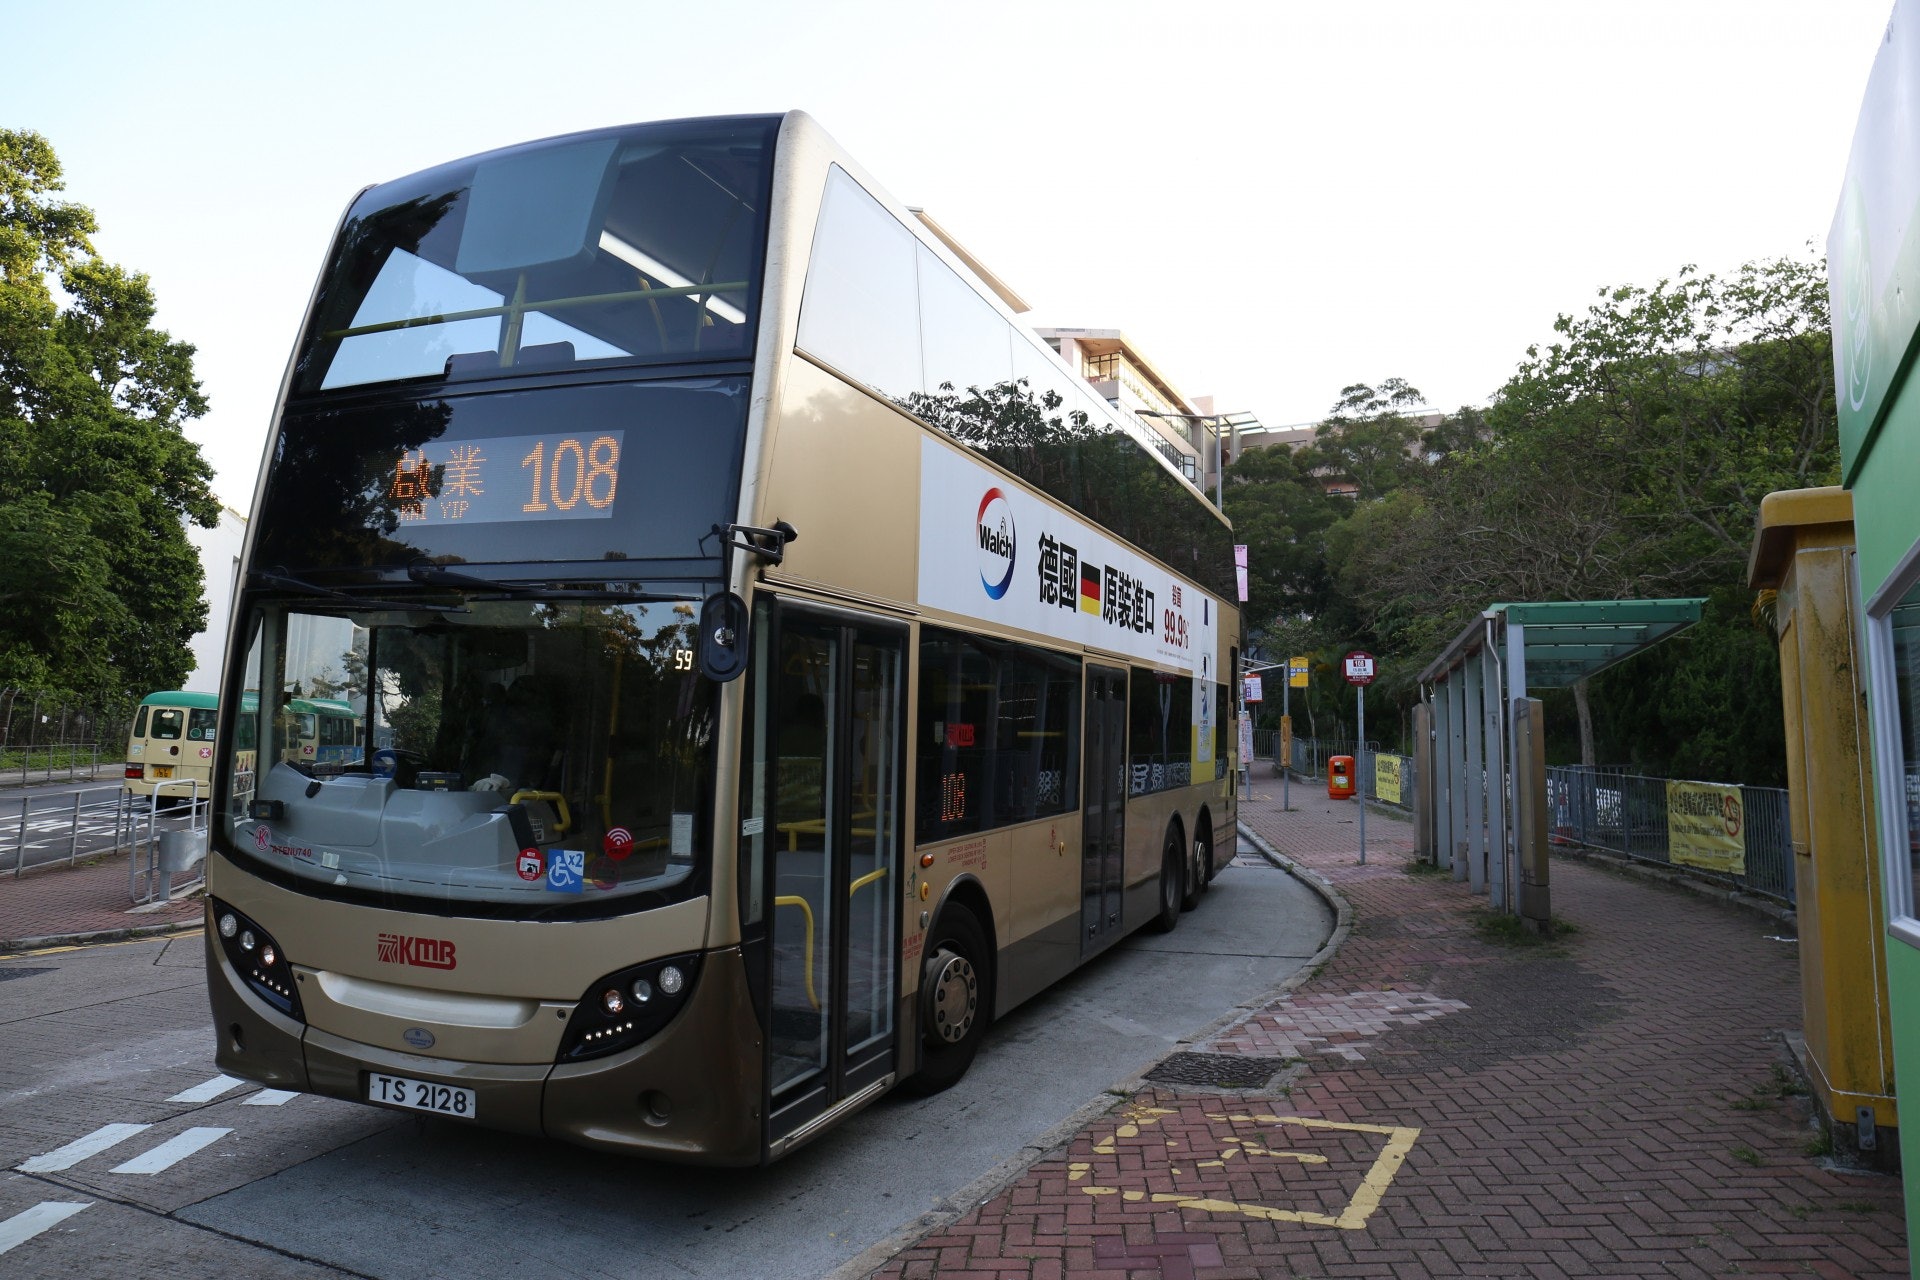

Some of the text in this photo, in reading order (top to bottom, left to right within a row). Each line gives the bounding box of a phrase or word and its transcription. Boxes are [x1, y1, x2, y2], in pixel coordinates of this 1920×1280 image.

[522, 436, 619, 512] 108
[440, 501, 470, 520] YIP
[979, 523, 1013, 560] Walch
[1037, 531, 1155, 635] 德國 原裝進口
[675, 649, 693, 670] 59
[941, 773, 965, 821] 108
[400, 935, 456, 970] KMB
[378, 1077, 467, 1114] TS 2128
